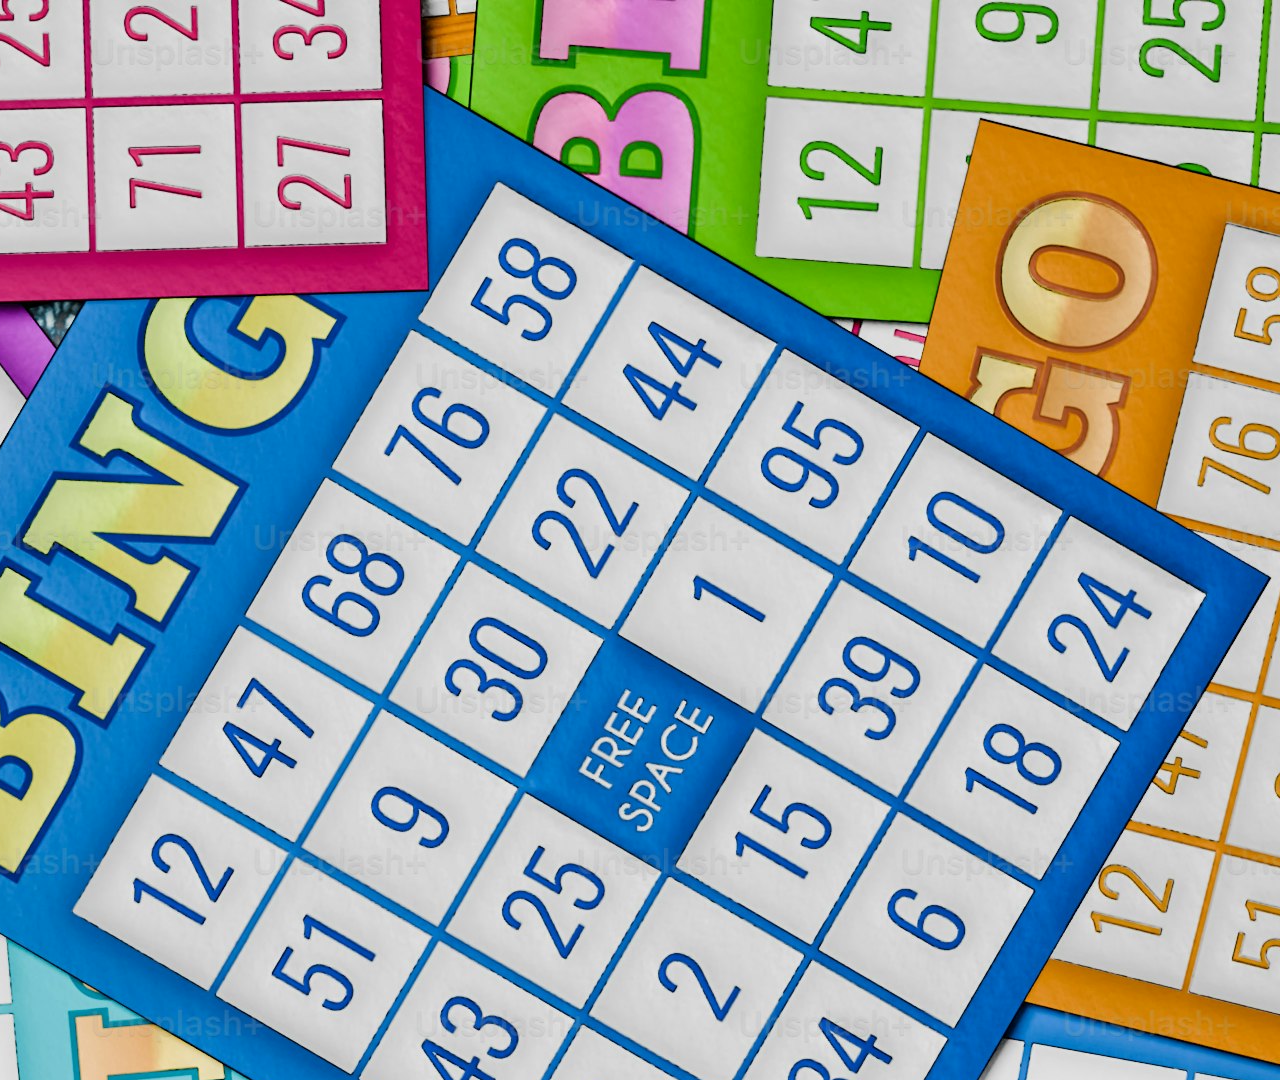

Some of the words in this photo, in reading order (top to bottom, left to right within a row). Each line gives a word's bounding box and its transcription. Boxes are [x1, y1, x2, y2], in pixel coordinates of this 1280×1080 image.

[976, 2, 1059, 44] 9
[128, 146, 202, 208] 71
[277, 137, 352, 210] 27
[797, 141, 883, 219] 12
[623, 322, 722, 420] 44
[384, 387, 490, 485] 76
[908, 492, 1004, 583] 10
[693, 576, 765, 622] 1
[445, 617, 548, 721] 30
[223, 678, 314, 777] 47
[580, 690, 656, 788] FREE
[619, 700, 713, 831] SPACE
[965, 724, 1062, 814] 18
[735, 785, 832, 879] 15
[133, 834, 234, 925] 12
[502, 846, 605, 959] 25
[272, 915, 376, 1011] 51
